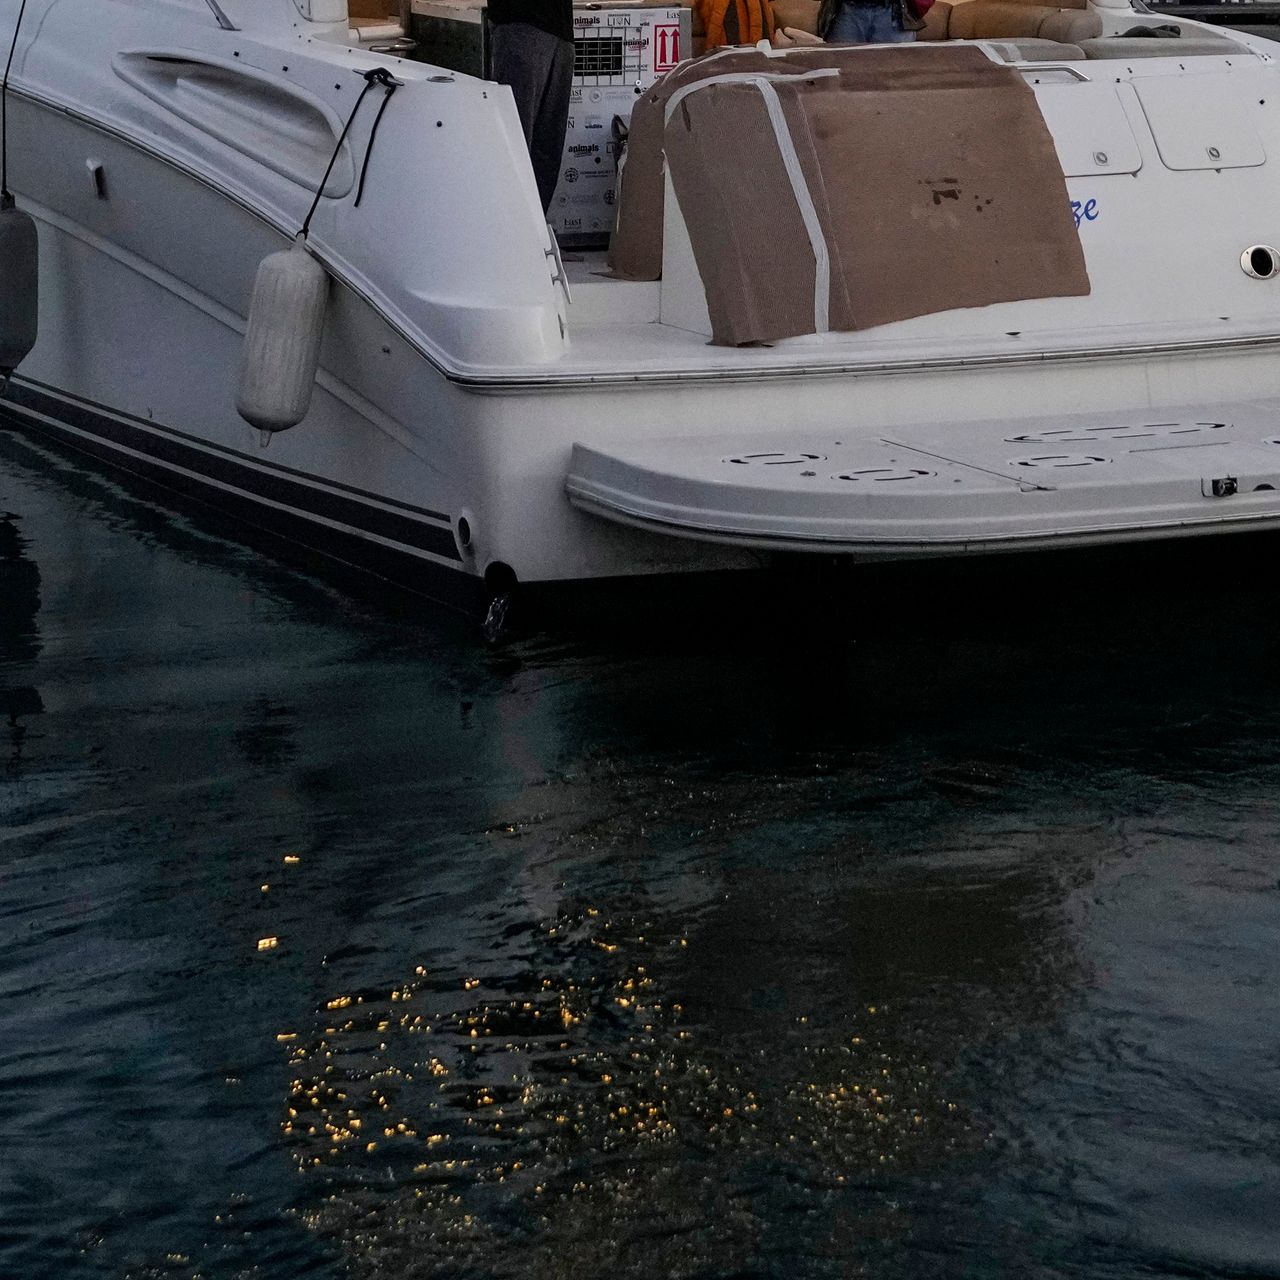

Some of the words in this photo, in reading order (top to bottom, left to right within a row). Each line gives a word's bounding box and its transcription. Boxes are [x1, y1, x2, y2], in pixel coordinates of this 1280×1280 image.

[574, 16, 601, 25] nimals
[568, 144, 600, 153] animals
[1071, 198, 1099, 231] ze
